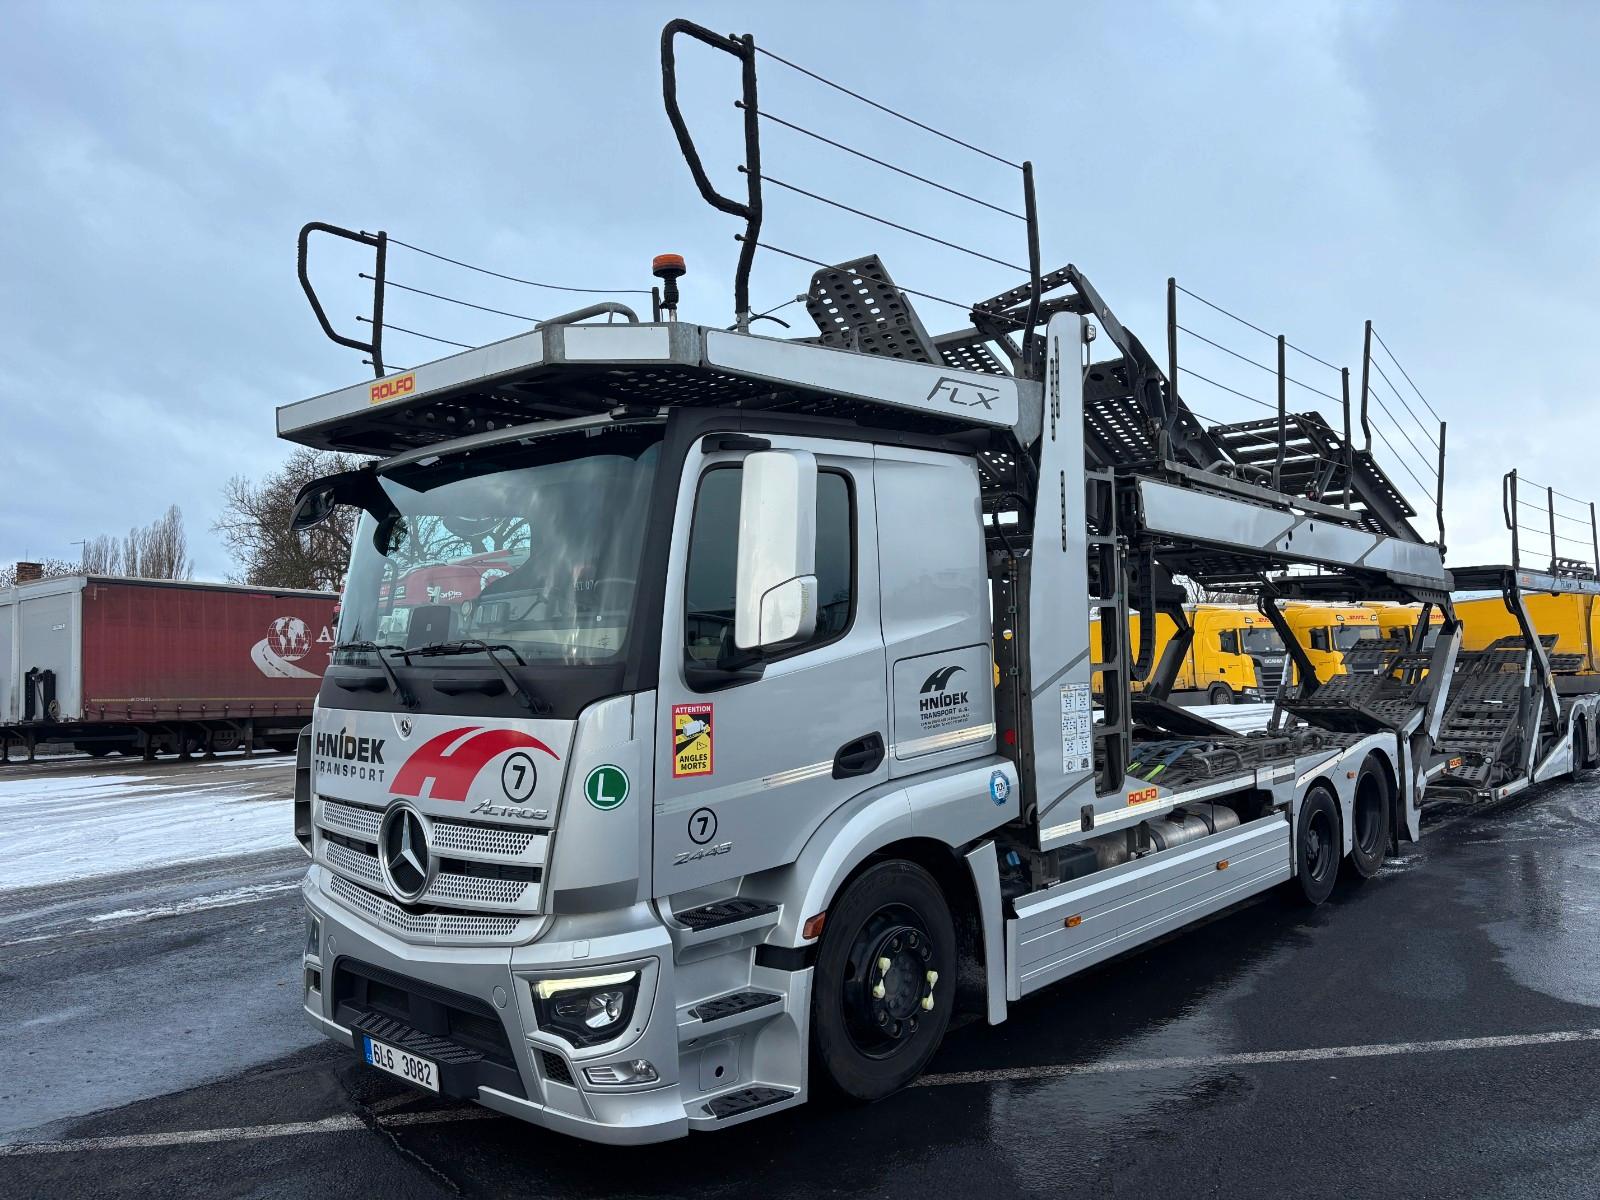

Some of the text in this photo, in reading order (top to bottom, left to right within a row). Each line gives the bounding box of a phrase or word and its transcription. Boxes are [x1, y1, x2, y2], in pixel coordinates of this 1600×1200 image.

[371, 376, 413, 401] ROLFO
[675, 705, 711, 714] ATTENTION
[919, 691, 969, 712] HNÍDEK
[920, 707, 957, 721] TRANSPORT
[316, 726, 386, 765] HNÍDEK
[679, 753, 708, 763] ANGLES
[680, 761, 707, 771] MORTS
[315, 759, 385, 783] TRANSPORT
[512, 764, 527, 790] 7
[597, 772, 616, 802] L
[1128, 788, 1157, 805] ROLFO
[697, 816, 708, 836] 7
[373, 1043, 432, 1086] 6L6 3082
